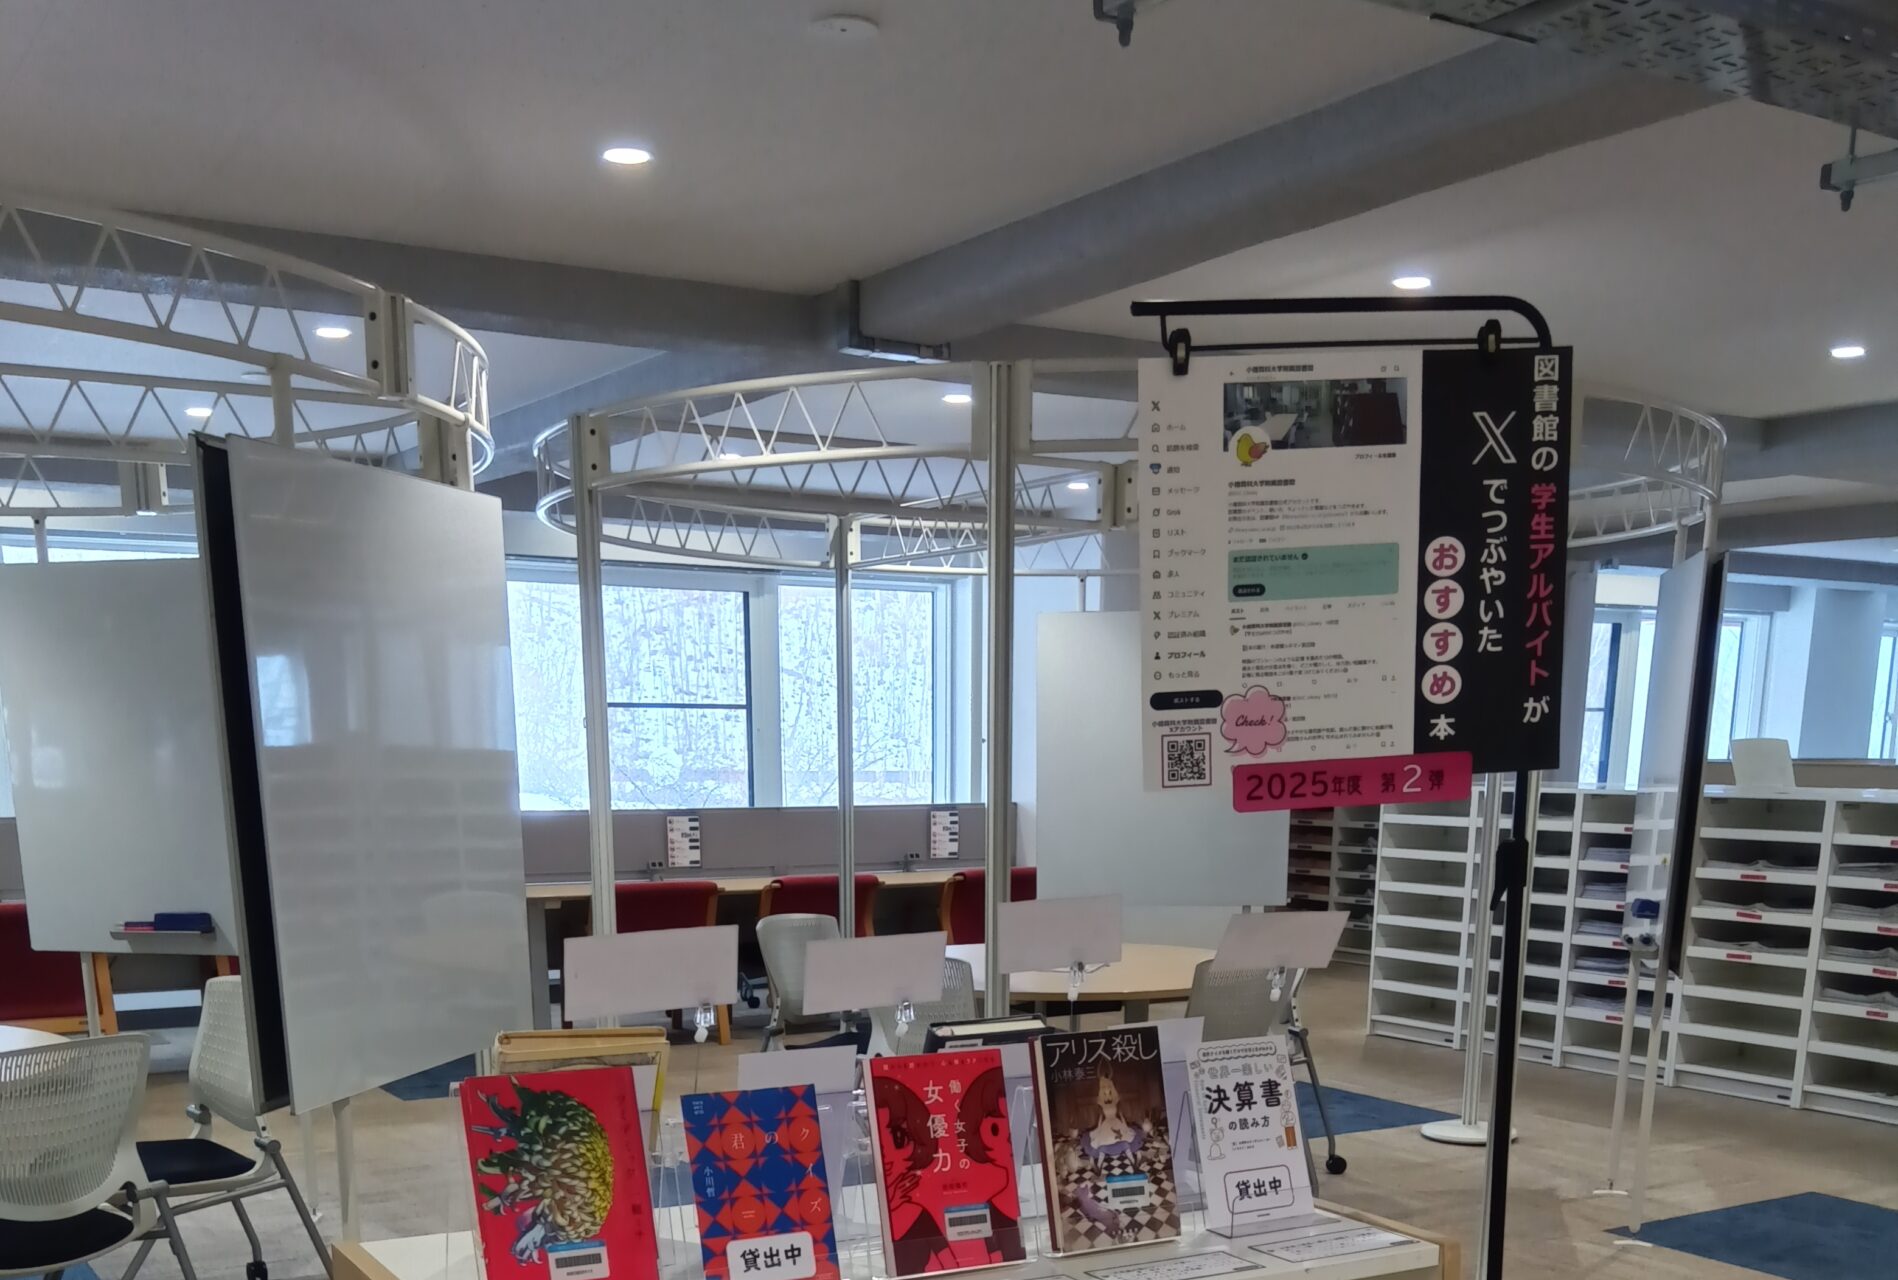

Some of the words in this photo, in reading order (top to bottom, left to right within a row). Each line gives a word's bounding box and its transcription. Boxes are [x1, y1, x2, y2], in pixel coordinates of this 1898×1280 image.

[1166, 423, 1187, 431] ホーム
[1471, 410, 1518, 465] X
[1167, 529, 1186, 537] リスト
[1167, 650, 1207, 660] プロフィール
[1235, 714, 1274, 728] Check!
[1246, 770, 1363, 801] 2025年度
[1380, 763, 1446, 794] 第2弾
[1045, 1032, 1159, 1069] アリス殺し
[1050, 1065, 1097, 1083] 小林泰三
[1204, 1078, 1284, 1116] 決算書
[922, 1079, 952, 1174] 女優力
[948, 1078, 971, 1171] 働く女子の
[1228, 1114, 1271, 1132] の読み方
[1235, 1175, 1283, 1202] 貸出中
[739, 1242, 803, 1274] 貸出中
